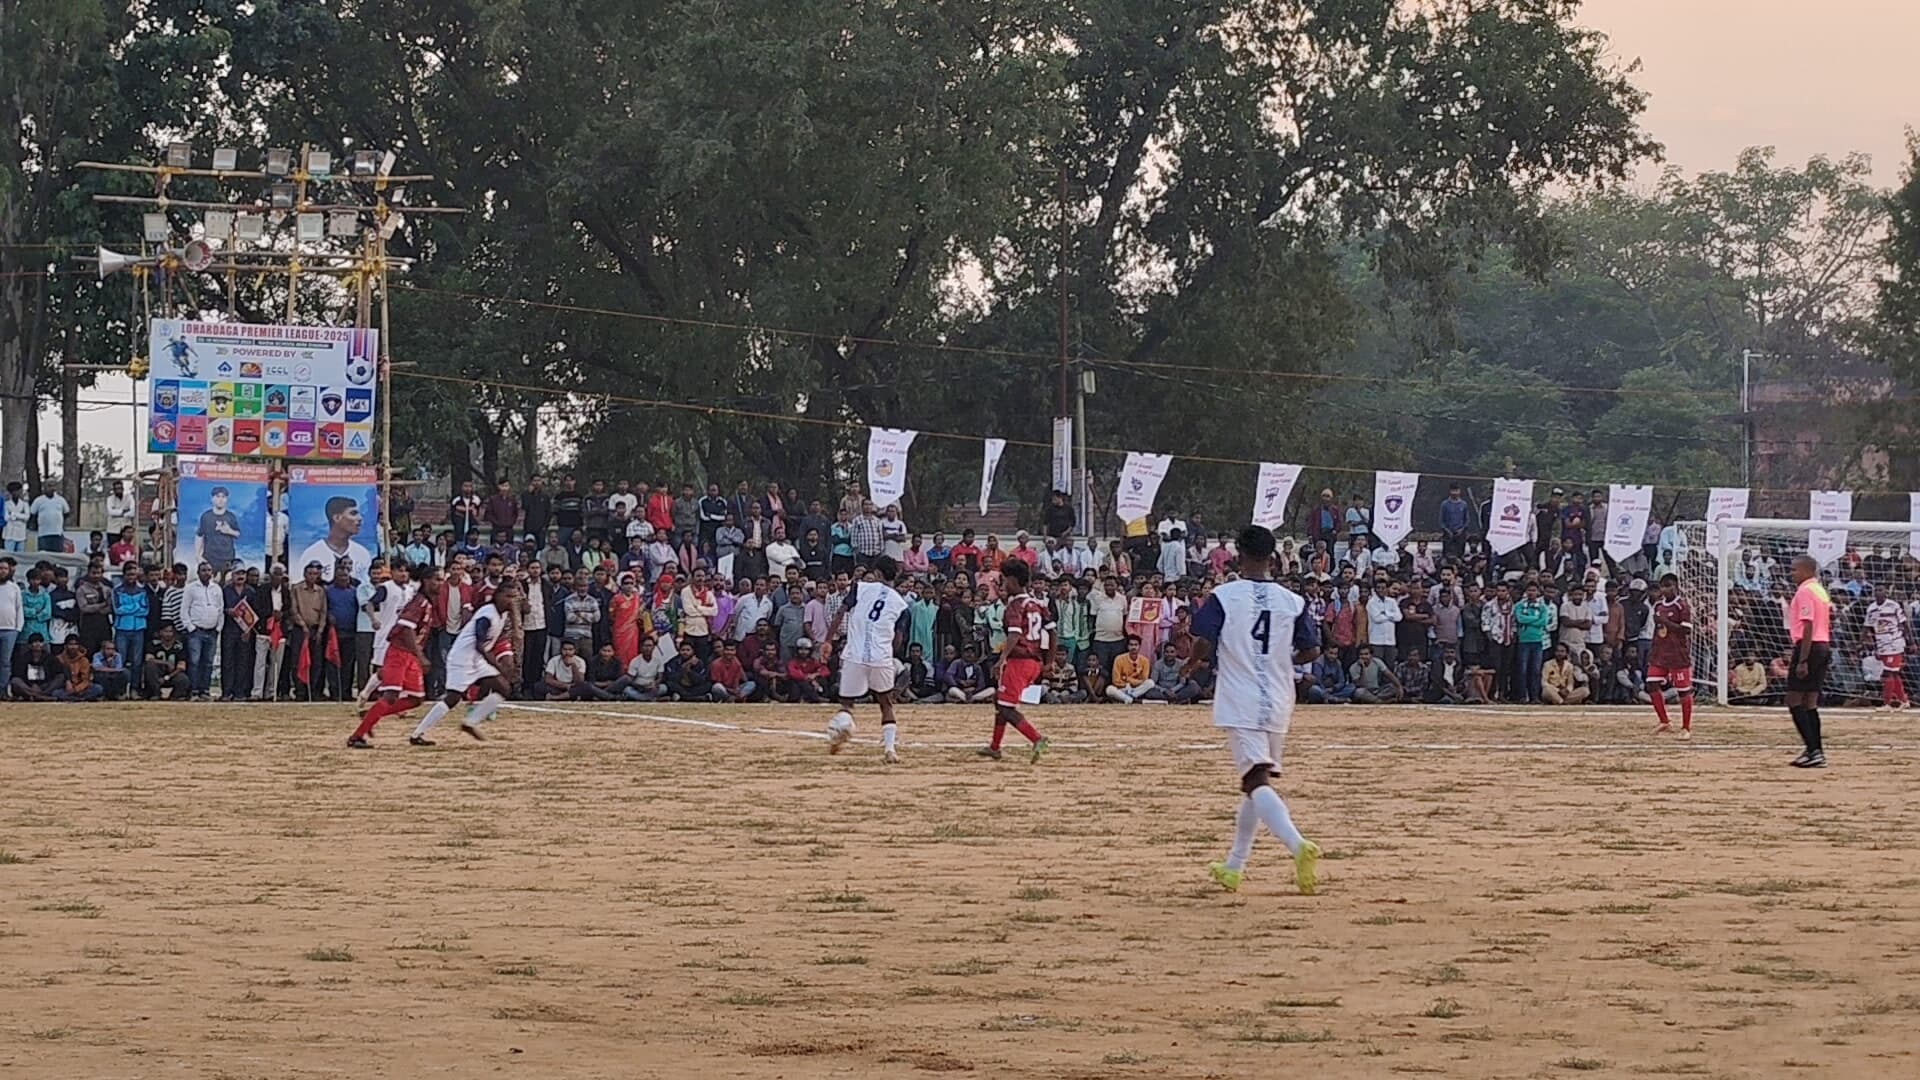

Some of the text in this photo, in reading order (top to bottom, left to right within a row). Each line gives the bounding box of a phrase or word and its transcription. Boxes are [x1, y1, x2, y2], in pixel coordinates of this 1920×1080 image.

[181, 323, 349, 341] LOHARDAGA PREMIER LEAGUE-2025
[232, 347, 297, 358] POWERED BY
[868, 599, 885, 622] 8
[1026, 611, 1042, 641] 12
[1251, 609, 1271, 655] 4
